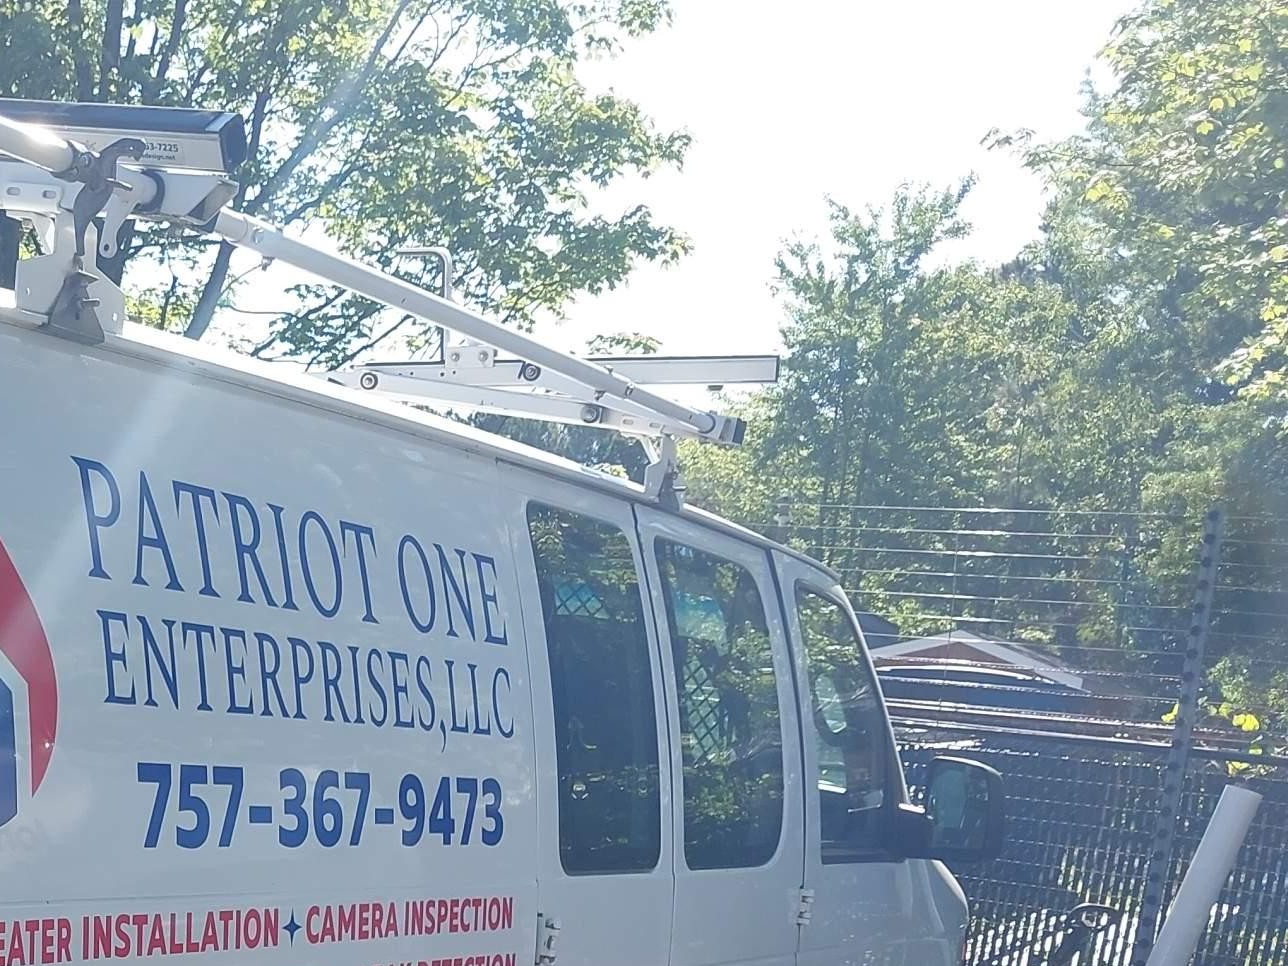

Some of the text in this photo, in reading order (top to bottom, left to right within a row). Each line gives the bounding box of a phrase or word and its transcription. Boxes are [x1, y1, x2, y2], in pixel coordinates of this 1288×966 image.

[71, 455, 508, 646] PATRIOT ONE
[137, 761, 505, 849] 757-367-9473
[82, 908, 279, 961] INSTALLATION
[305, 902, 399, 945] CAMERA
[404, 896, 513, 937] INSPECTION
